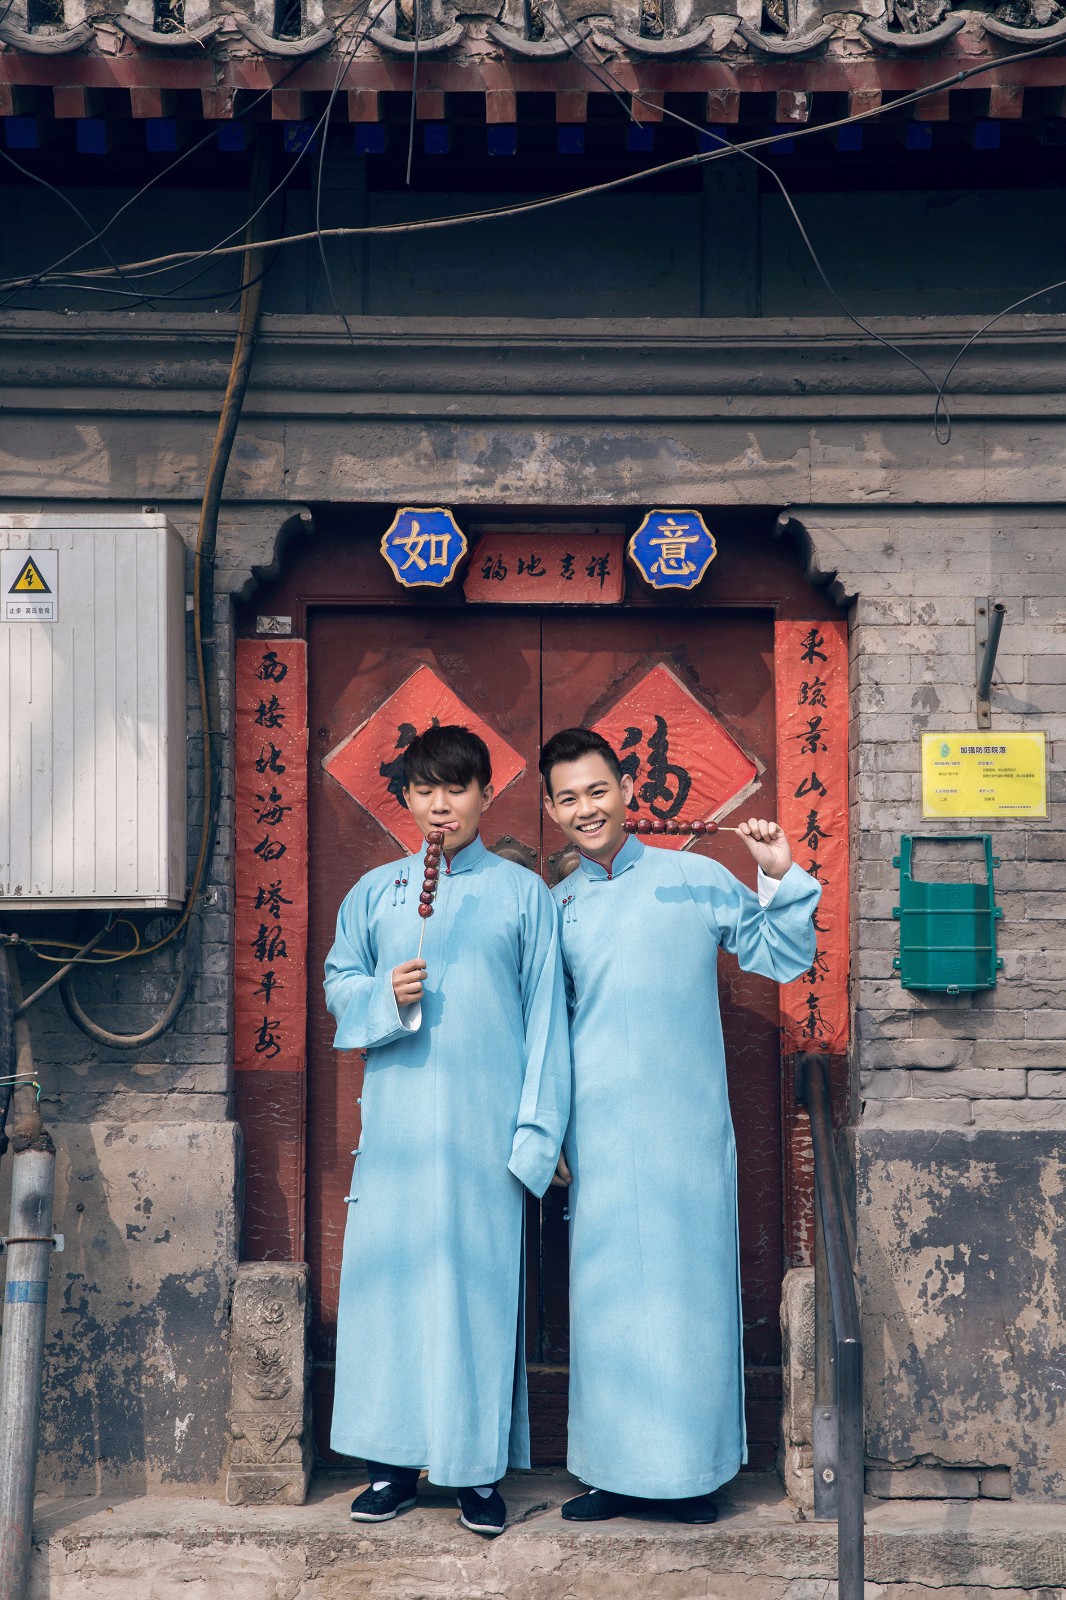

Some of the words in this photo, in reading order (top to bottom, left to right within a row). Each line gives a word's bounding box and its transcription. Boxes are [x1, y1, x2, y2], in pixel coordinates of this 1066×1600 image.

[392, 520, 451, 571] 如
[481, 553, 611, 589] 福地吉祥
[649, 518, 699, 576] 意
[618, 714, 692, 820] 福
[960, 746, 1007, 754] 加强防范院落
